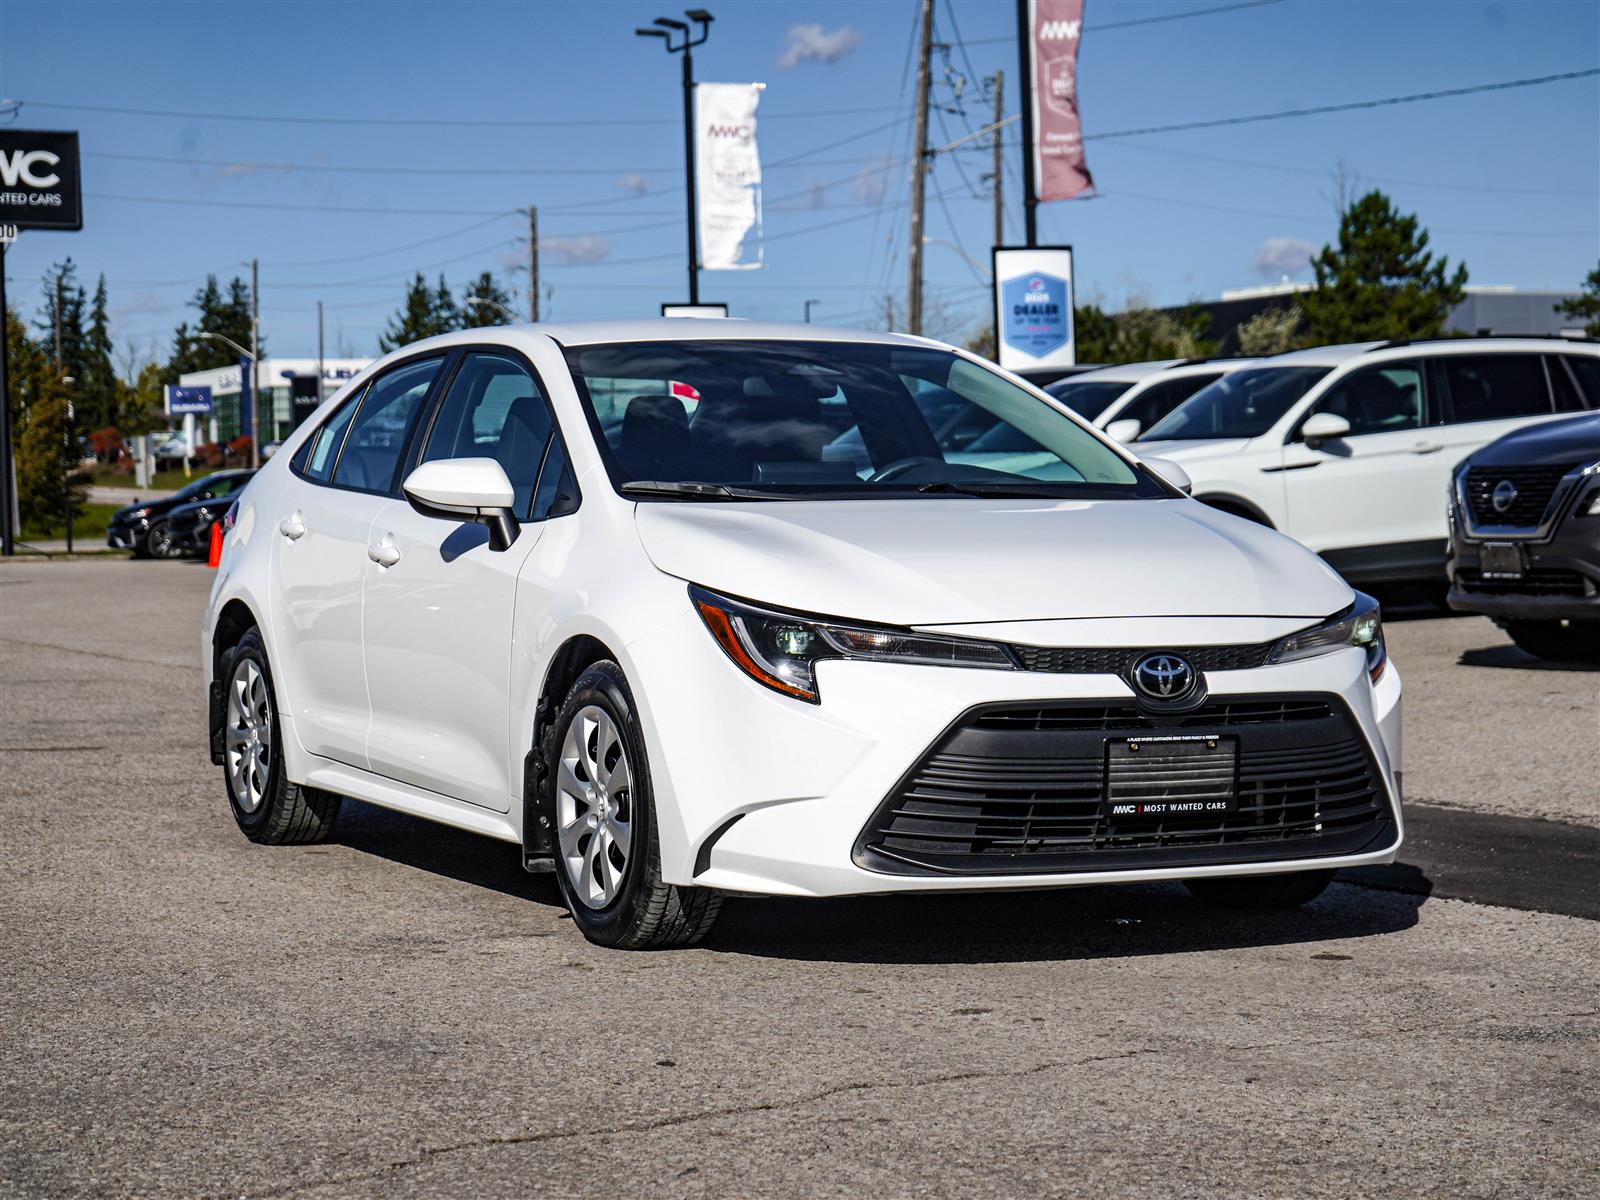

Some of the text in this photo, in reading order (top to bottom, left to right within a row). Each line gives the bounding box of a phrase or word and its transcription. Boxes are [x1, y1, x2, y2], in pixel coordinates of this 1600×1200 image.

[29, 193, 62, 206] CARS
[1013, 304, 1058, 315] DEALER
[1113, 802, 1226, 814] MWC MOST WANTED CARS
